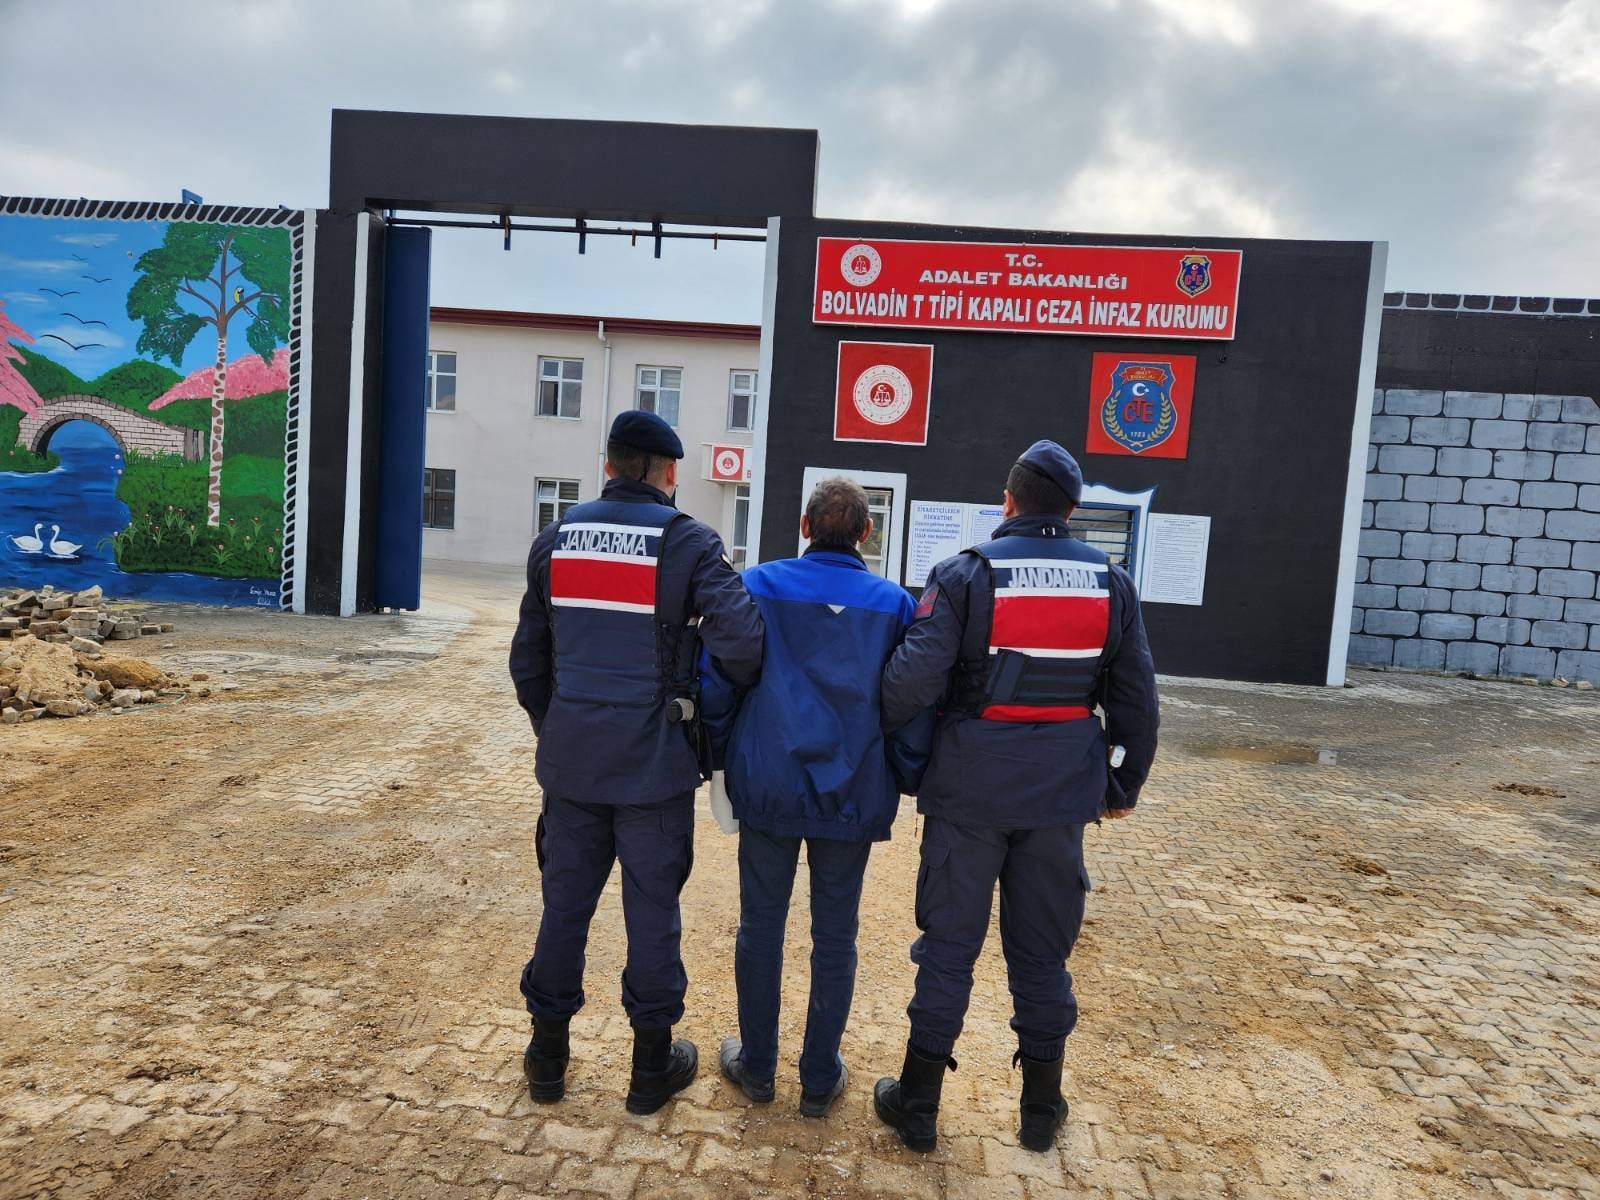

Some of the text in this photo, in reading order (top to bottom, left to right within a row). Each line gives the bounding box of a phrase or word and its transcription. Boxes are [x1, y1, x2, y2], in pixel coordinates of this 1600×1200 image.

[1004, 253, 1043, 268] T.C.
[919, 269, 1128, 290] ADALET BAKANLIĞI
[820, 286, 1229, 331] BOLVADİN T TİPİ KAPALI CEZA İNFAZ KURUMU
[561, 529, 647, 556] JANDARMA
[1008, 567, 1099, 589] JANDARMA
